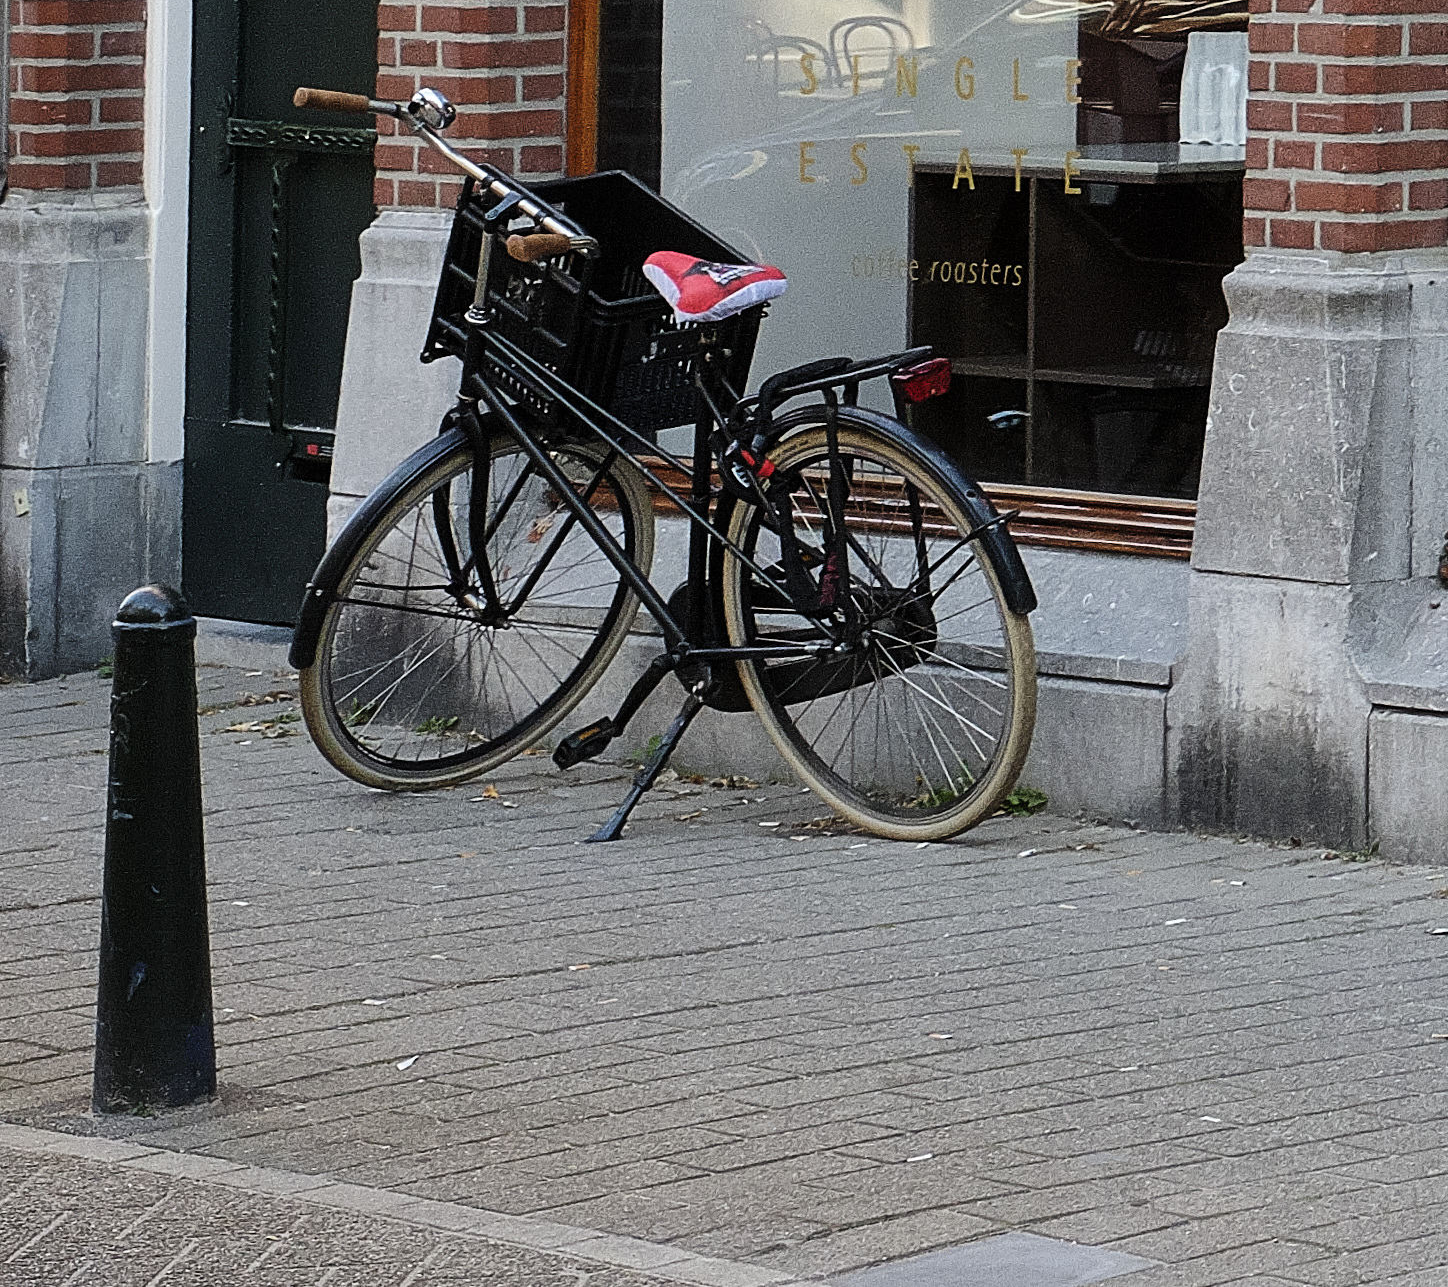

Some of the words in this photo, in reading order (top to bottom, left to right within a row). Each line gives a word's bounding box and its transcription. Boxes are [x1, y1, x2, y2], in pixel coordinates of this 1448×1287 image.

[800, 53, 1083, 104] SINGLE
[799, 141, 1082, 195] ESTATE
[930, 258, 1023, 287] roasters
